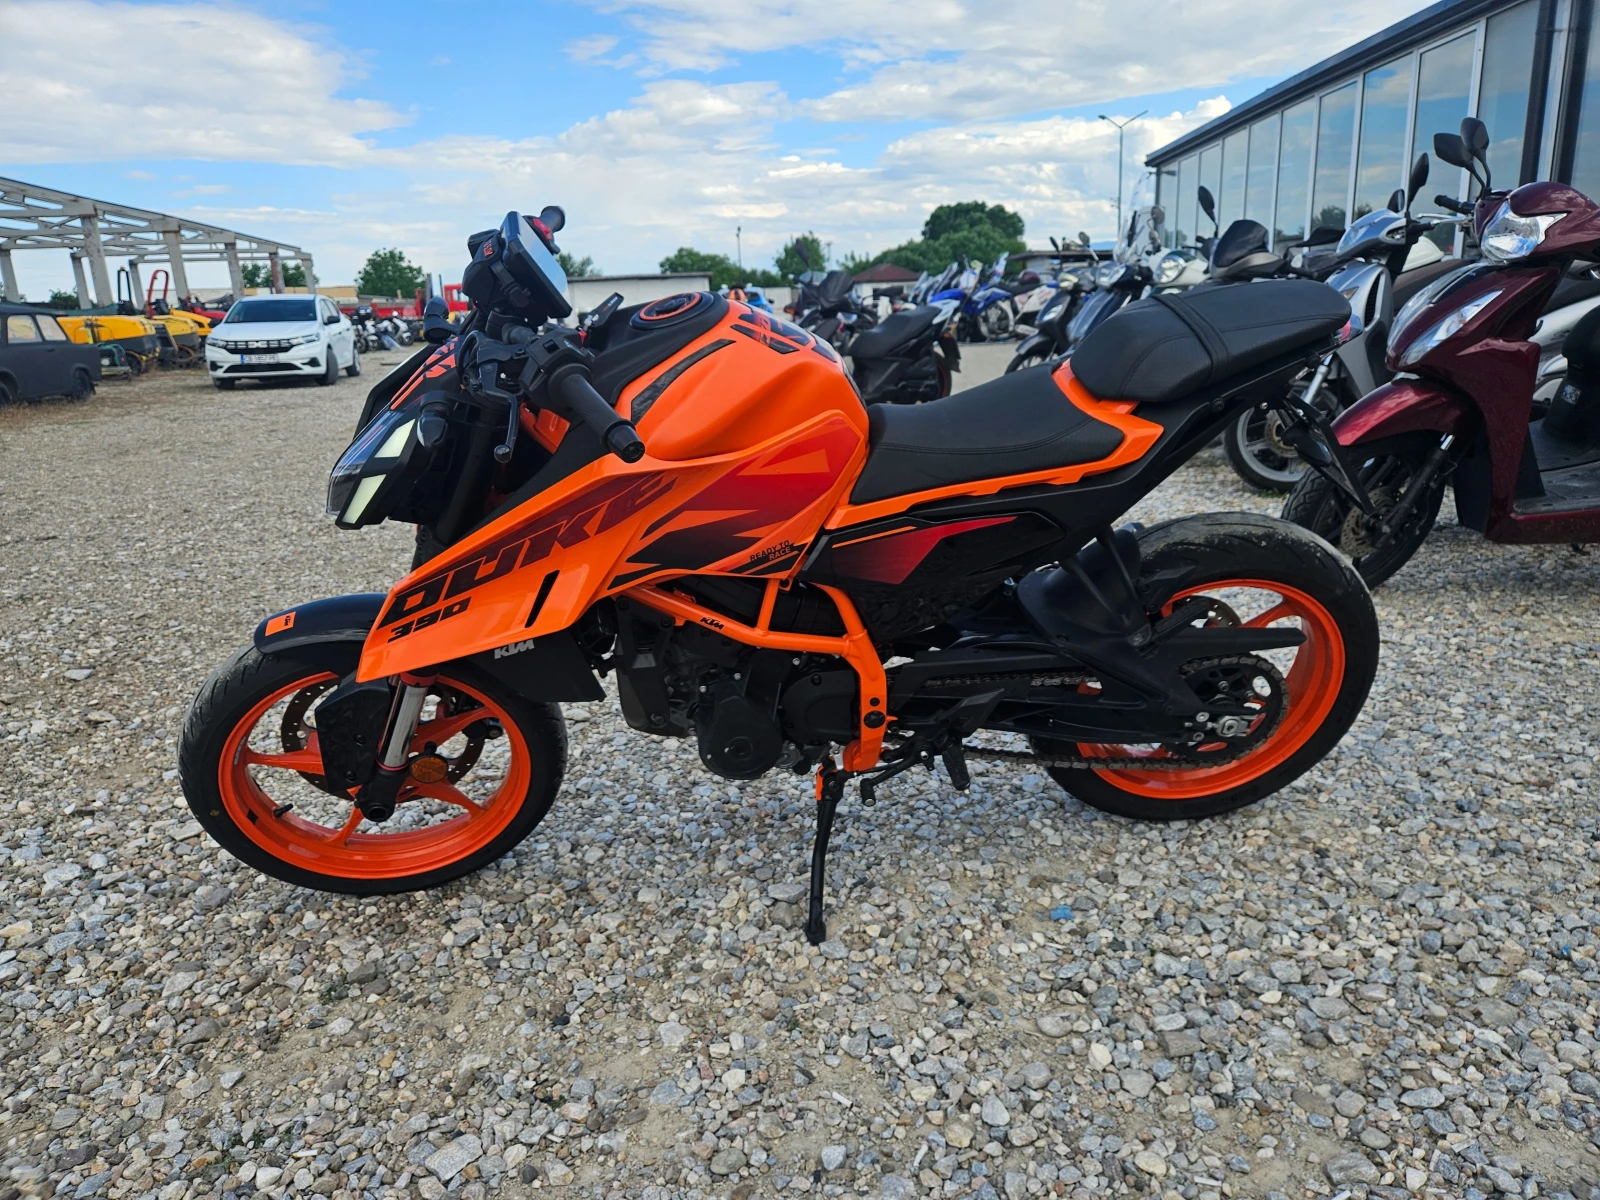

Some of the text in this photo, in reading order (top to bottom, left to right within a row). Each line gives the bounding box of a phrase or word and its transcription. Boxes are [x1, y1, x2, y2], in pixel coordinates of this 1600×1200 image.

[376, 472, 678, 630] DUKE
[750, 540, 790, 561] READY TO
[769, 546, 791, 561] RACE
[388, 596, 472, 643] 390
[700, 616, 725, 630] KTM
[494, 638, 535, 660] KTM
